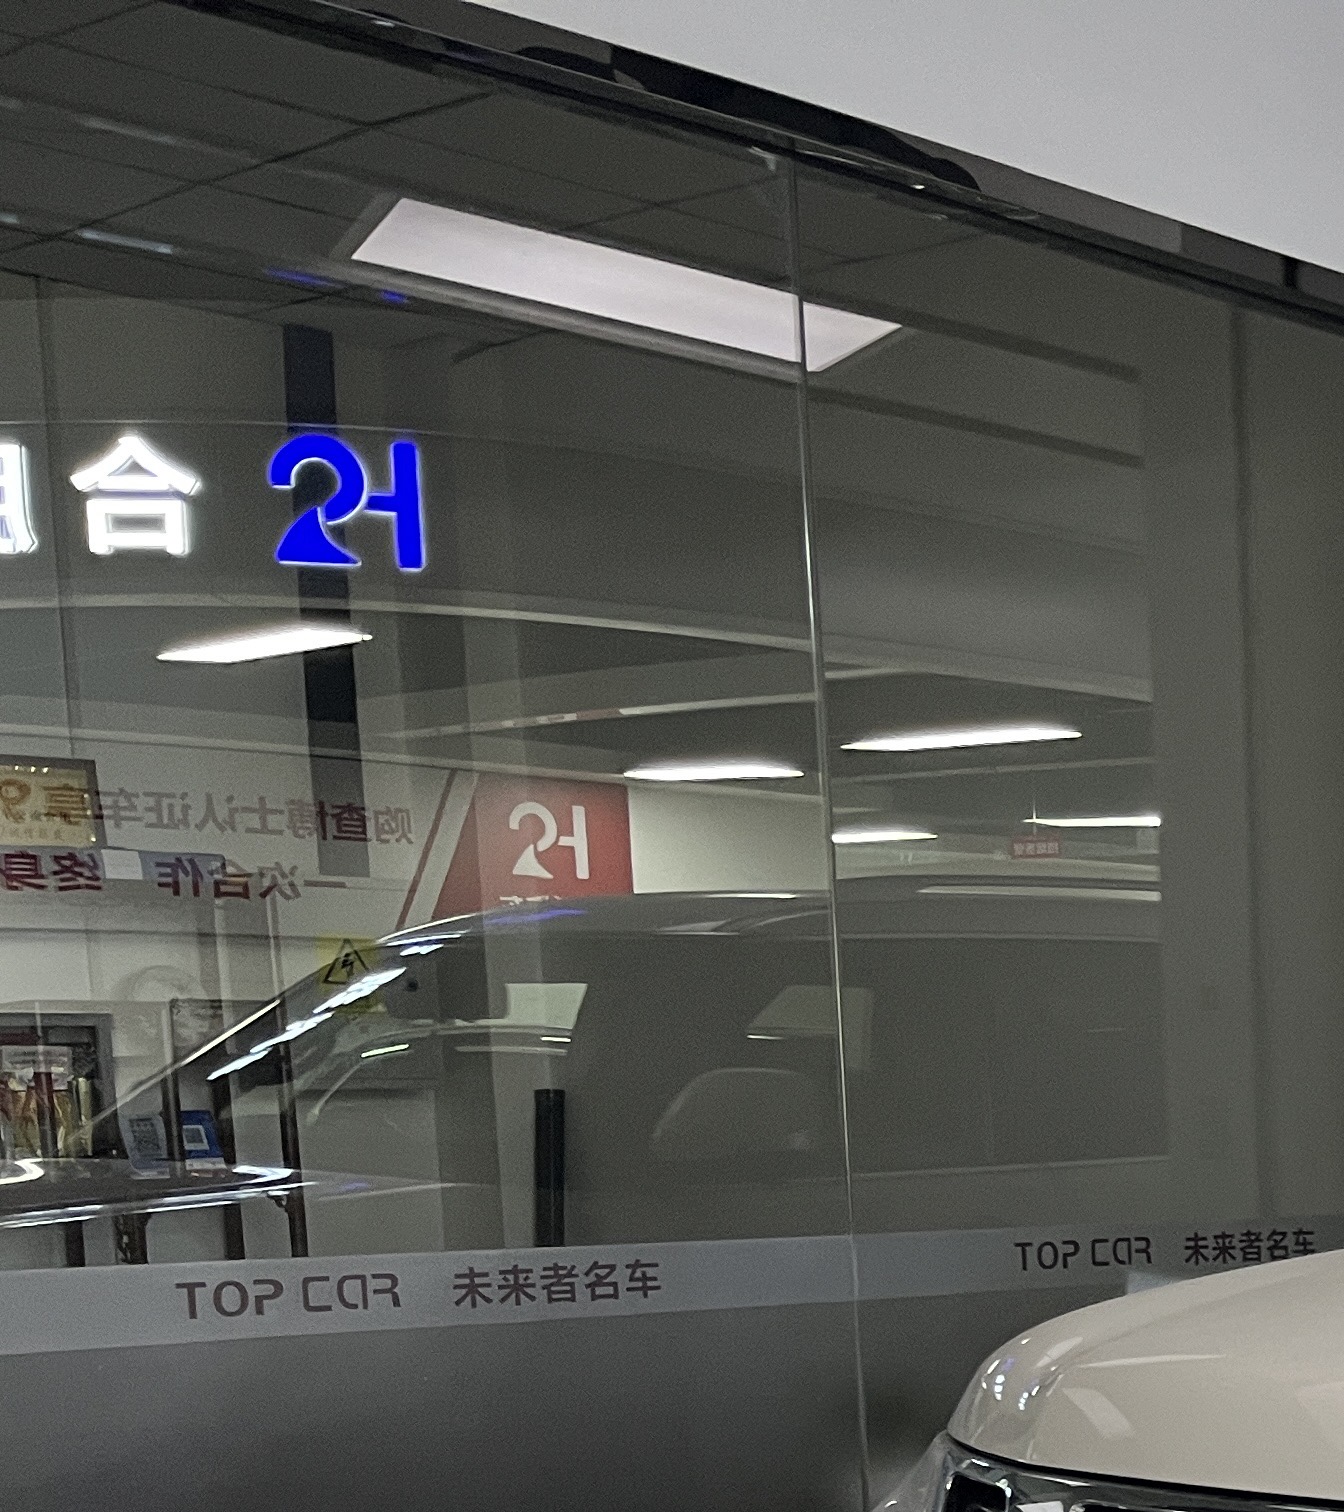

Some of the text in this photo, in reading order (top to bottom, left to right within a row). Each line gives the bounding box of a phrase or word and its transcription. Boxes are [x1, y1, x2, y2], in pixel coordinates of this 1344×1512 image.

[1013, 1239, 1081, 1271] TOP
[1184, 1227, 1316, 1267] 未来者名车
[175, 1278, 284, 1321] TOP
[452, 1258, 663, 1310] 未来者名车
